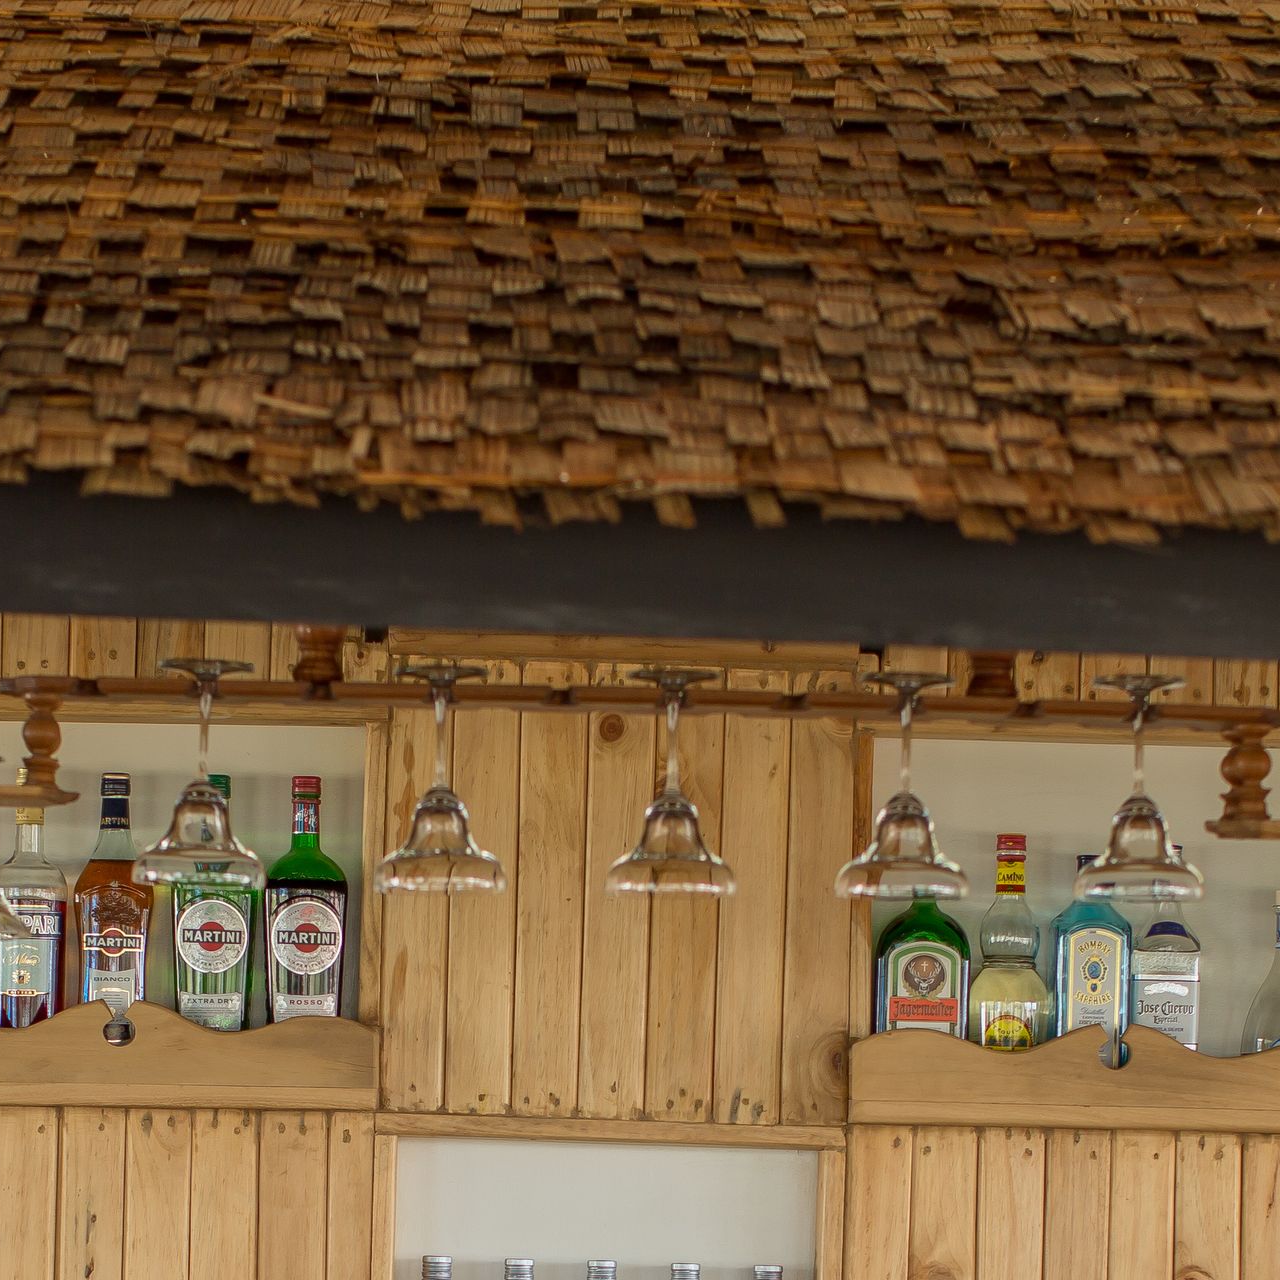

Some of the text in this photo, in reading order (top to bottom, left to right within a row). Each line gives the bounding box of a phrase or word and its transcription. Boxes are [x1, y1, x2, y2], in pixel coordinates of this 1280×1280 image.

[100, 816, 130, 826] ARTINI
[997, 871, 1025, 882] CAMINO
[86, 936, 141, 948] MARTINI
[184, 930, 241, 944] MARTINI
[278, 932, 336, 946] MARTINI
[1078, 940, 1112, 956] BOMBAY
[186, 997, 234, 1005] EXTRA DRY
[1074, 991, 1113, 1006] SAPPHIRE
[1137, 1000, 1195, 1016] Jose Cuervo
